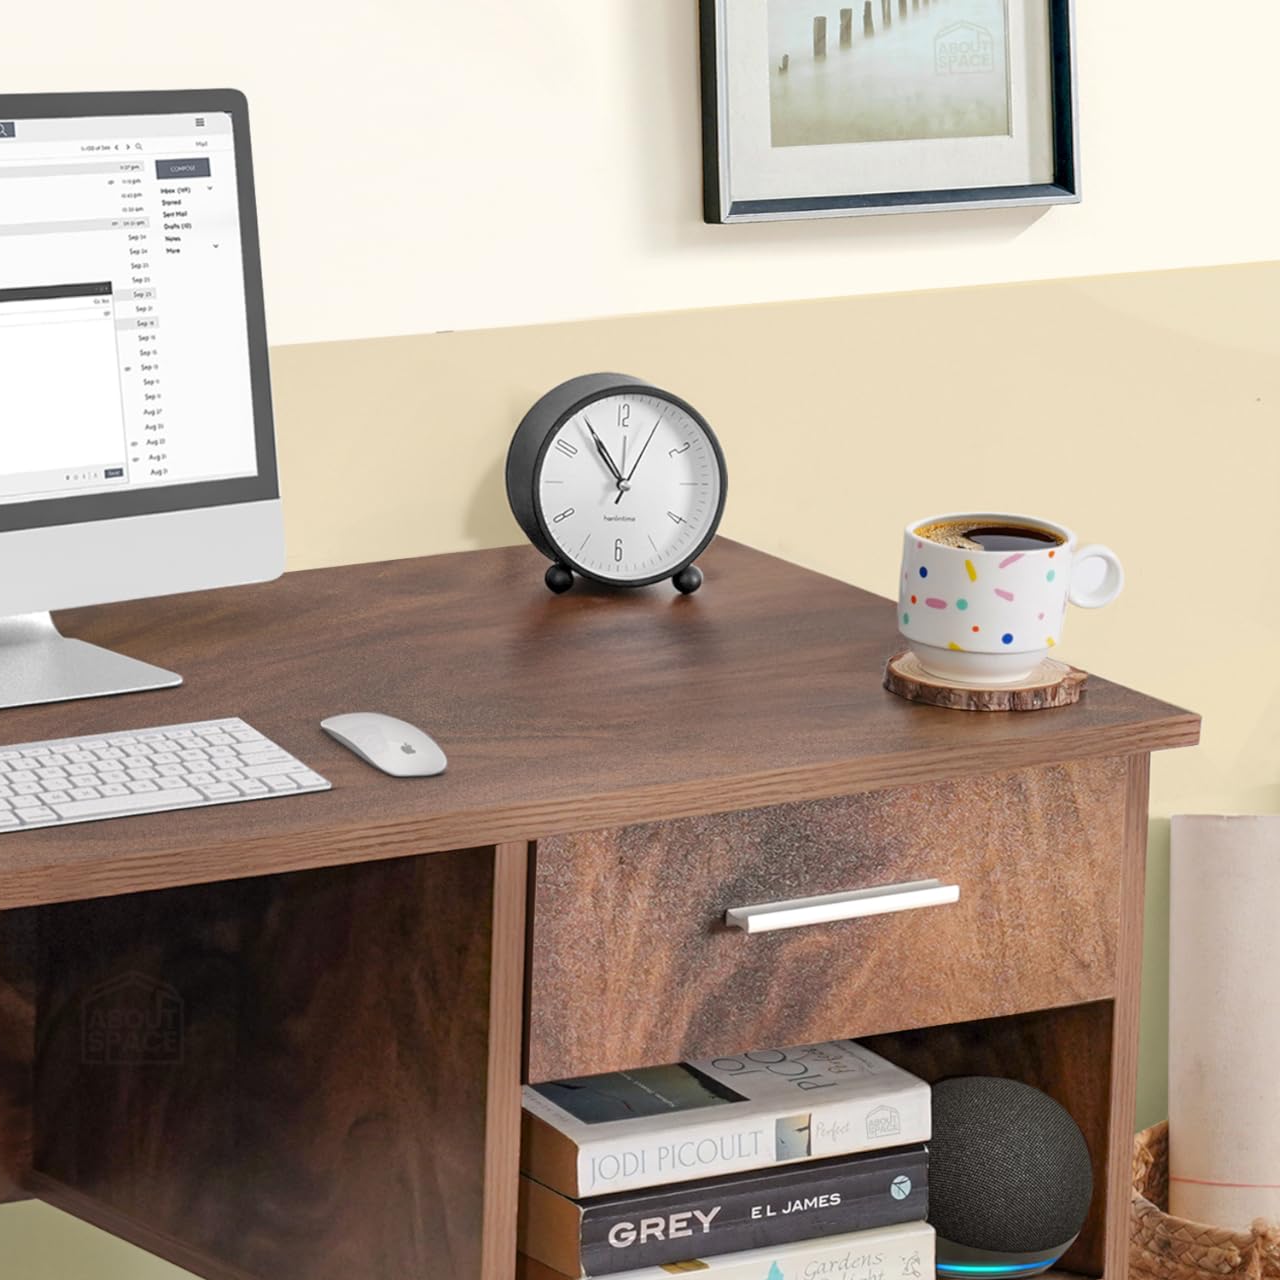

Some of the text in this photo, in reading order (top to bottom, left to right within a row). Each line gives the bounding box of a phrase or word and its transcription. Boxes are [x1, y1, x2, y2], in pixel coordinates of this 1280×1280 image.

[175, 210, 187, 218] Mail
[129, 247, 140, 255] Sep
[136, 319, 147, 327] Sep
[140, 363, 152, 371] Sep
[143, 408, 155, 416] Aug
[617, 403, 630, 427] 12
[144, 423, 156, 431] Aug
[555, 439, 578, 458] 10
[668, 441, 691, 458] 2
[150, 468, 162, 476] Aug
[553, 508, 575, 524] 8
[667, 511, 688, 524] 4
[615, 538, 623, 562] 6
[711, 1058, 765, 1077] JO
[815, 1121, 851, 1144] Perfect
[590, 1130, 763, 1188] JODI PICOULT
[751, 1193, 842, 1219] E L JAMES
[608, 1206, 722, 1248] GREY
[804, 1252, 884, 1278] Gardens
